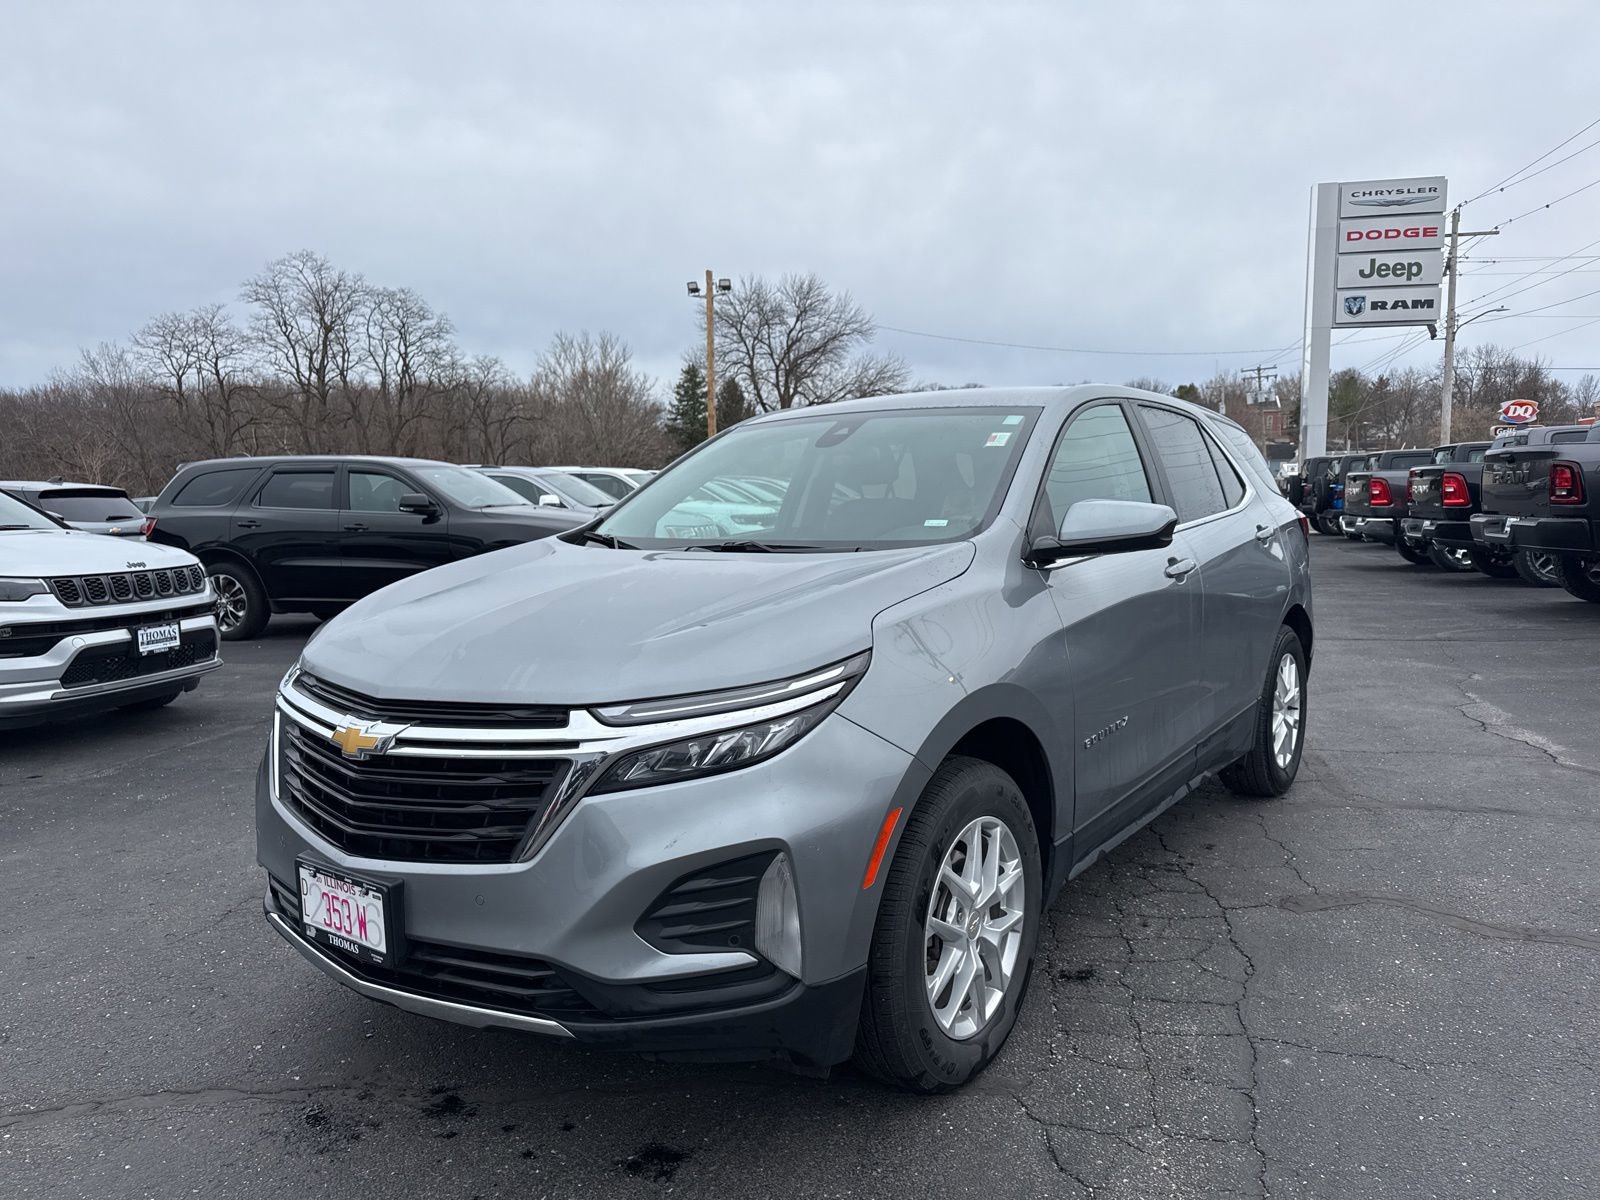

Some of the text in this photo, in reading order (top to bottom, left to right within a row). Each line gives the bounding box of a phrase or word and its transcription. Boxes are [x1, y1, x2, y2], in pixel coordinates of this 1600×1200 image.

[1351, 186, 1438, 198] CHRYSLER
[1346, 227, 1439, 241] DODGE
[1358, 258, 1423, 281] Jeep
[1370, 299, 1435, 311] RAM
[1507, 405, 1533, 418] DQ
[1492, 471, 1530, 485] RAM
[140, 628, 177, 641] THOMAS
[323, 875, 356, 896] ILLINOIS
[321, 891, 368, 941] 353 W
[328, 934, 359, 954] THOMAS
